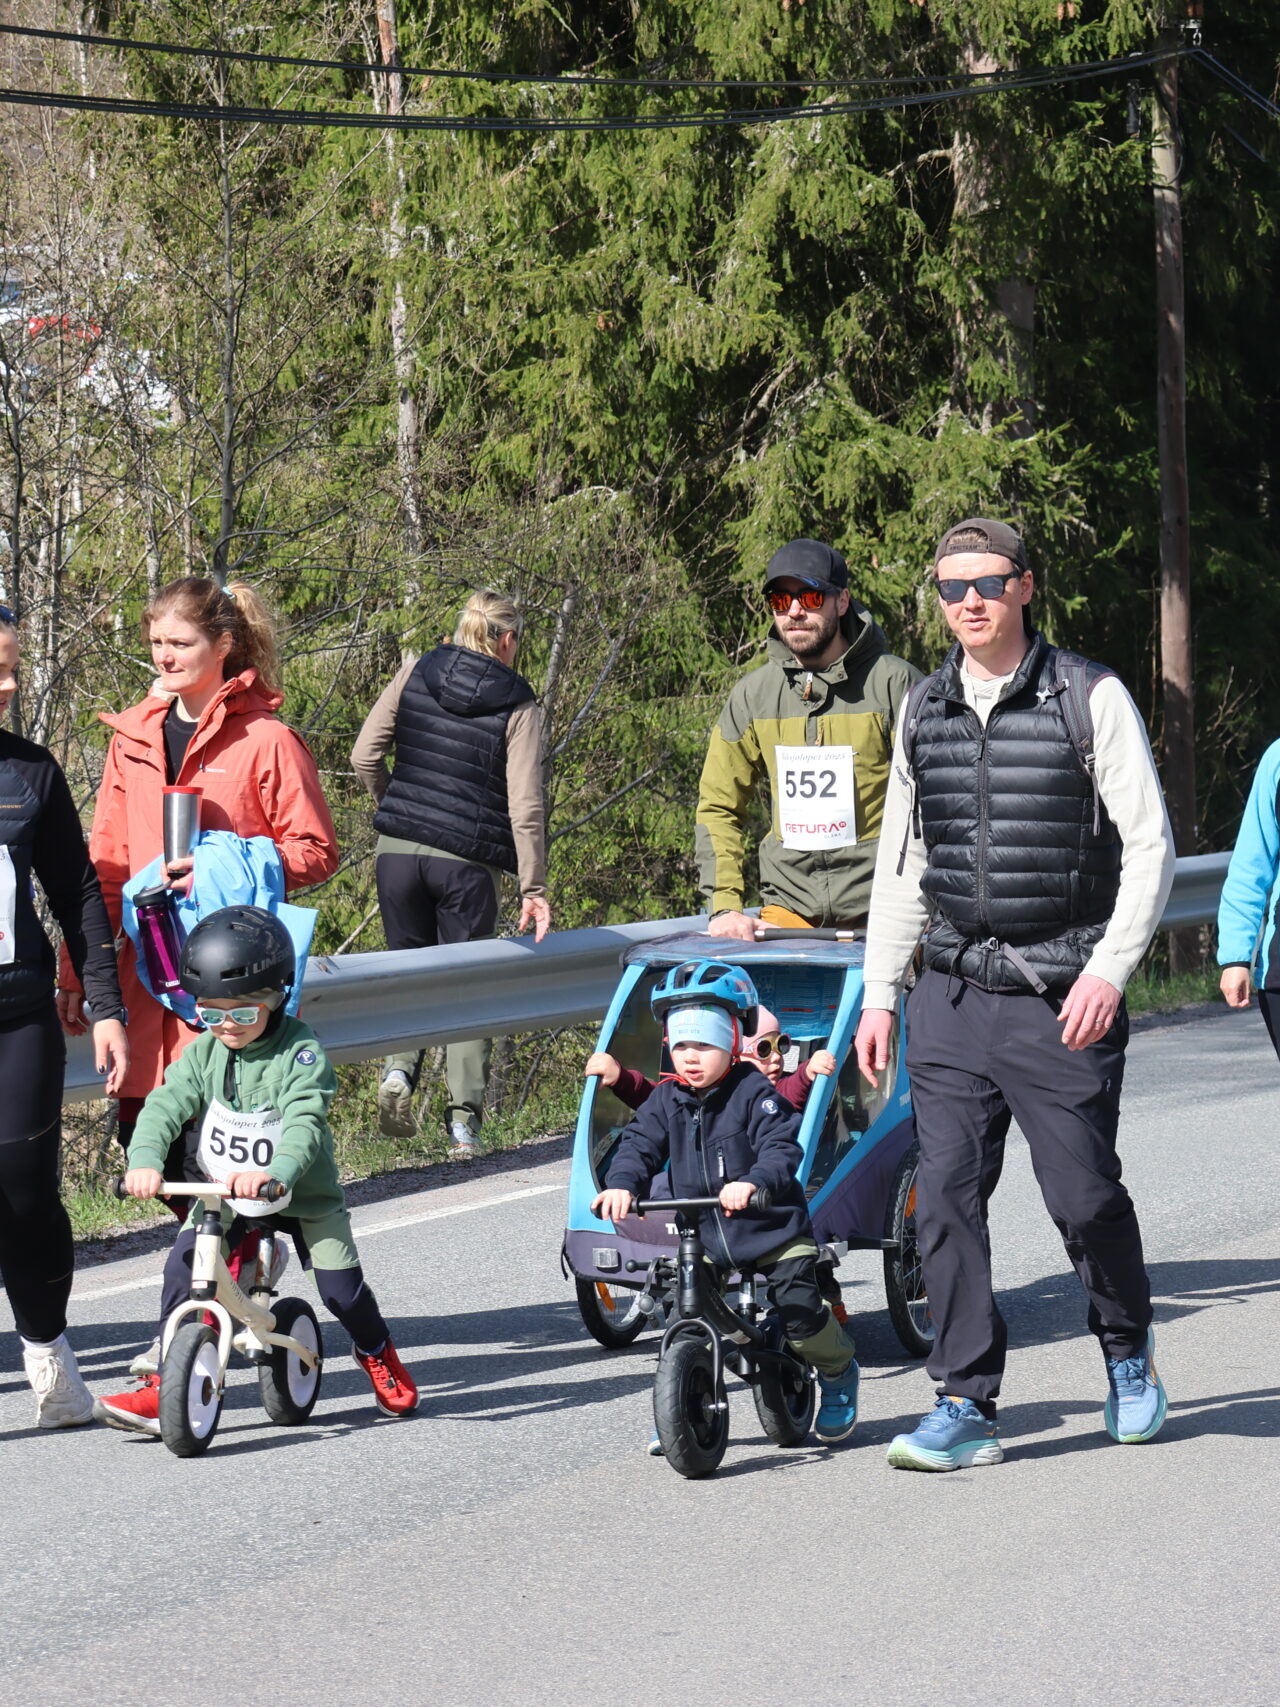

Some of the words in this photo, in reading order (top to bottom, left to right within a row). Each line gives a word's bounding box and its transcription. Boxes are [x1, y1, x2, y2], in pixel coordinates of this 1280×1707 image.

[785, 770, 837, 798] 552
[785, 823, 840, 834] RETURA
[208, 1126, 275, 1168] 550
